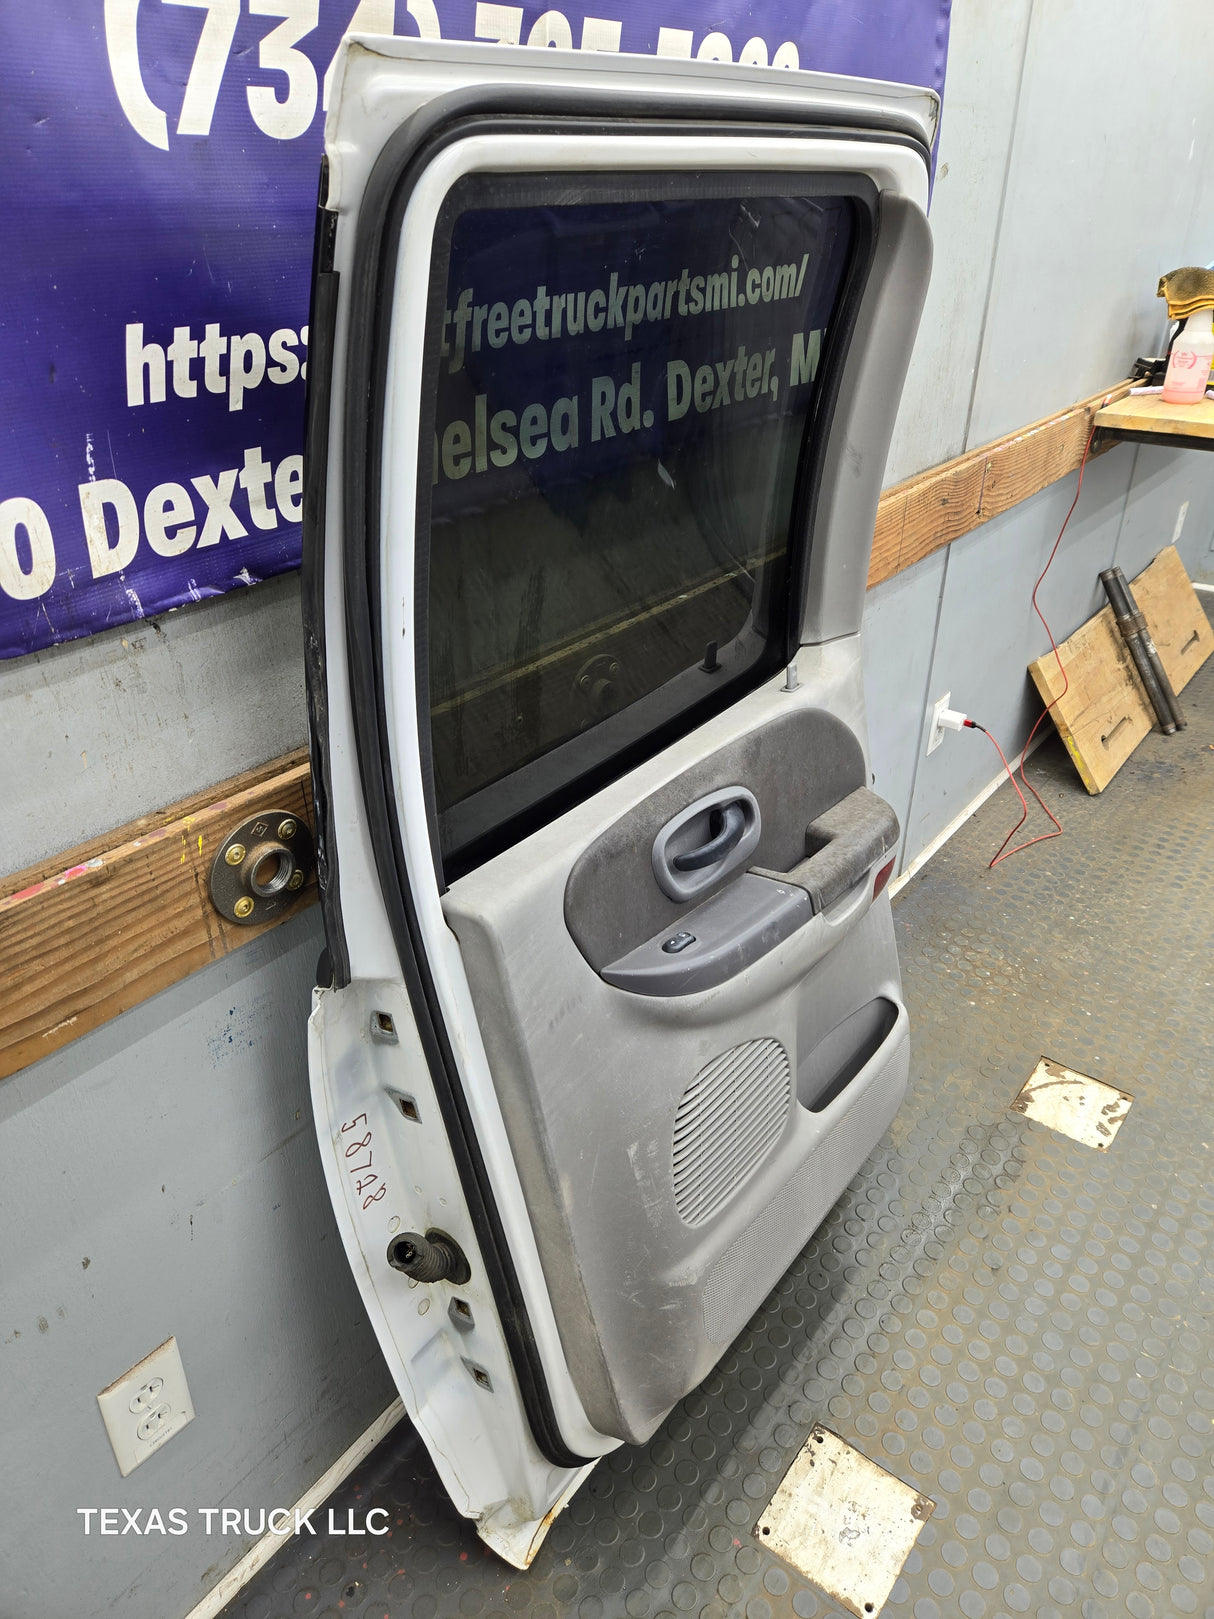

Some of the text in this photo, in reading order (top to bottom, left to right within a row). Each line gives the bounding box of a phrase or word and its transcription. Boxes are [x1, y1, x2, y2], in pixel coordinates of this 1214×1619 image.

[432, 394, 579, 486] elsea
[591, 363, 655, 443] Rd.
[667, 345, 779, 423] Dexter,
[789, 328, 827, 387] M
